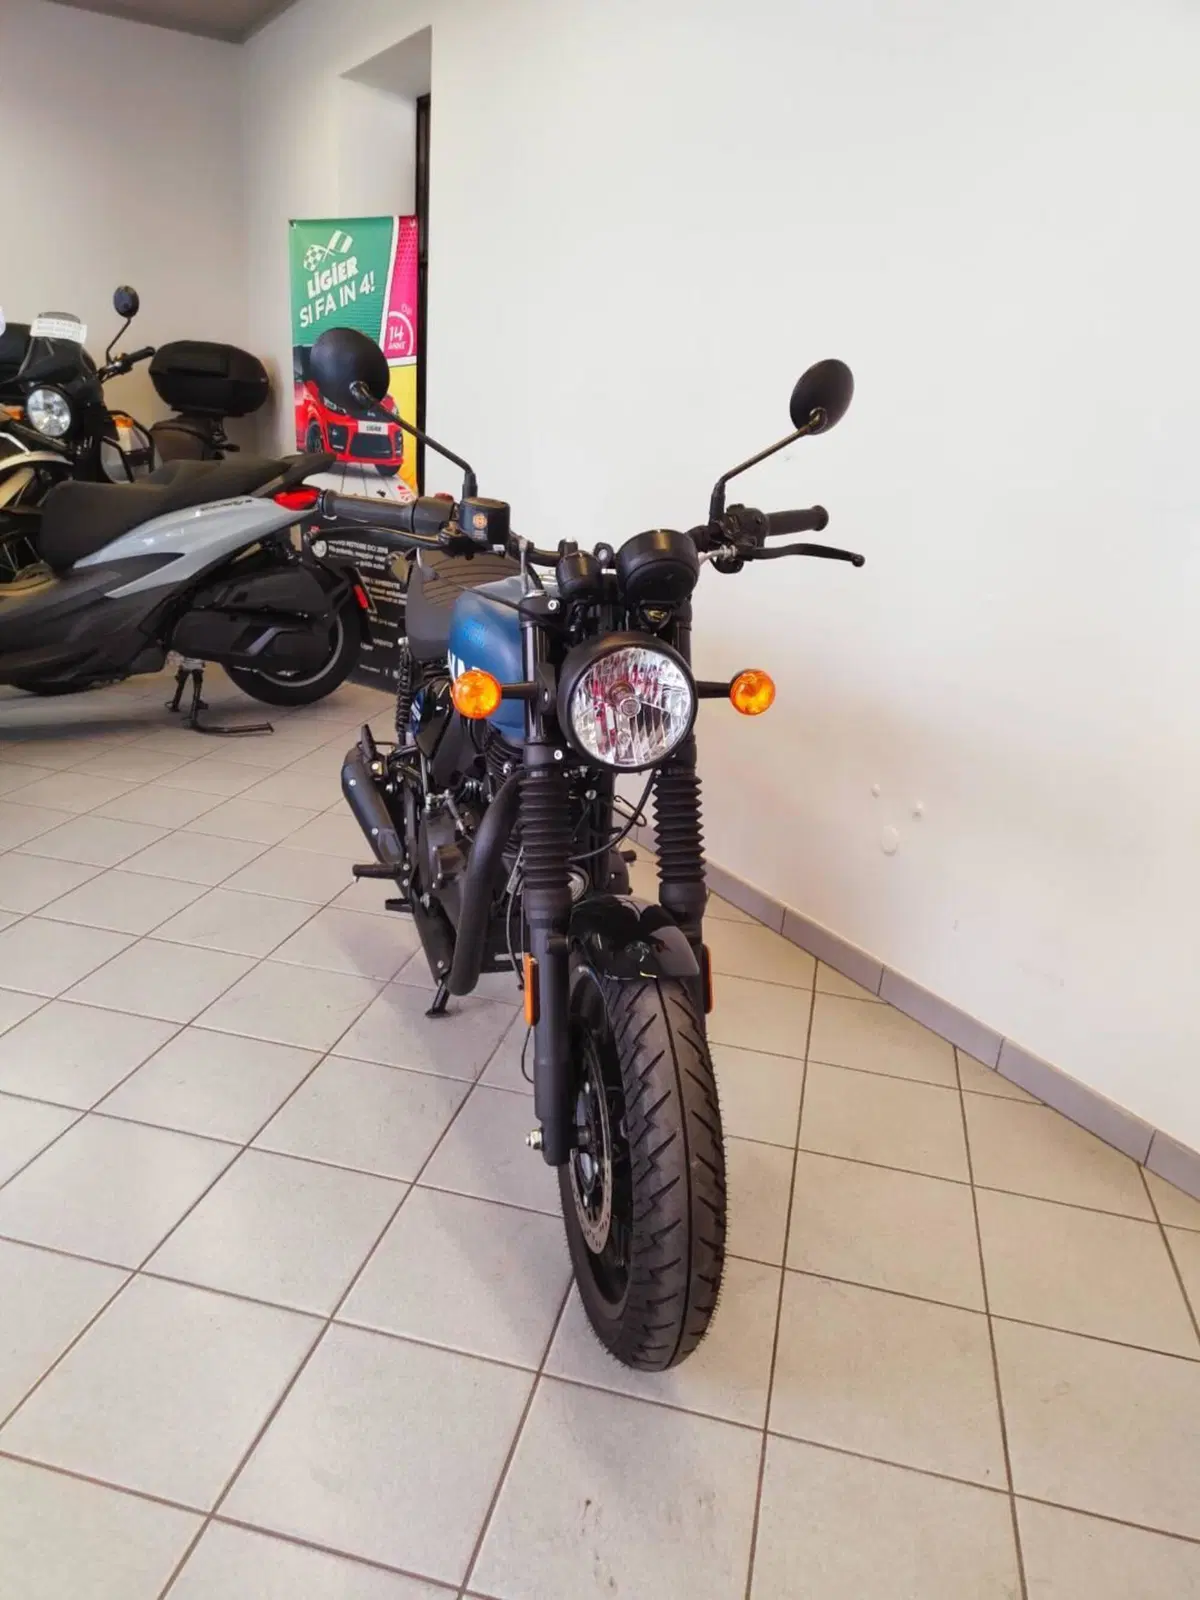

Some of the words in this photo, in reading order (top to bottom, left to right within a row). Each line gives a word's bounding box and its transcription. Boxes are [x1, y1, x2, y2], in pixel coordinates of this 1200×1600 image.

[300, 303, 313, 328] SI
[315, 293, 337, 321] FA
[340, 280, 357, 307] IN
[360, 270, 375, 295] 4!
[389, 324, 404, 342] 14
